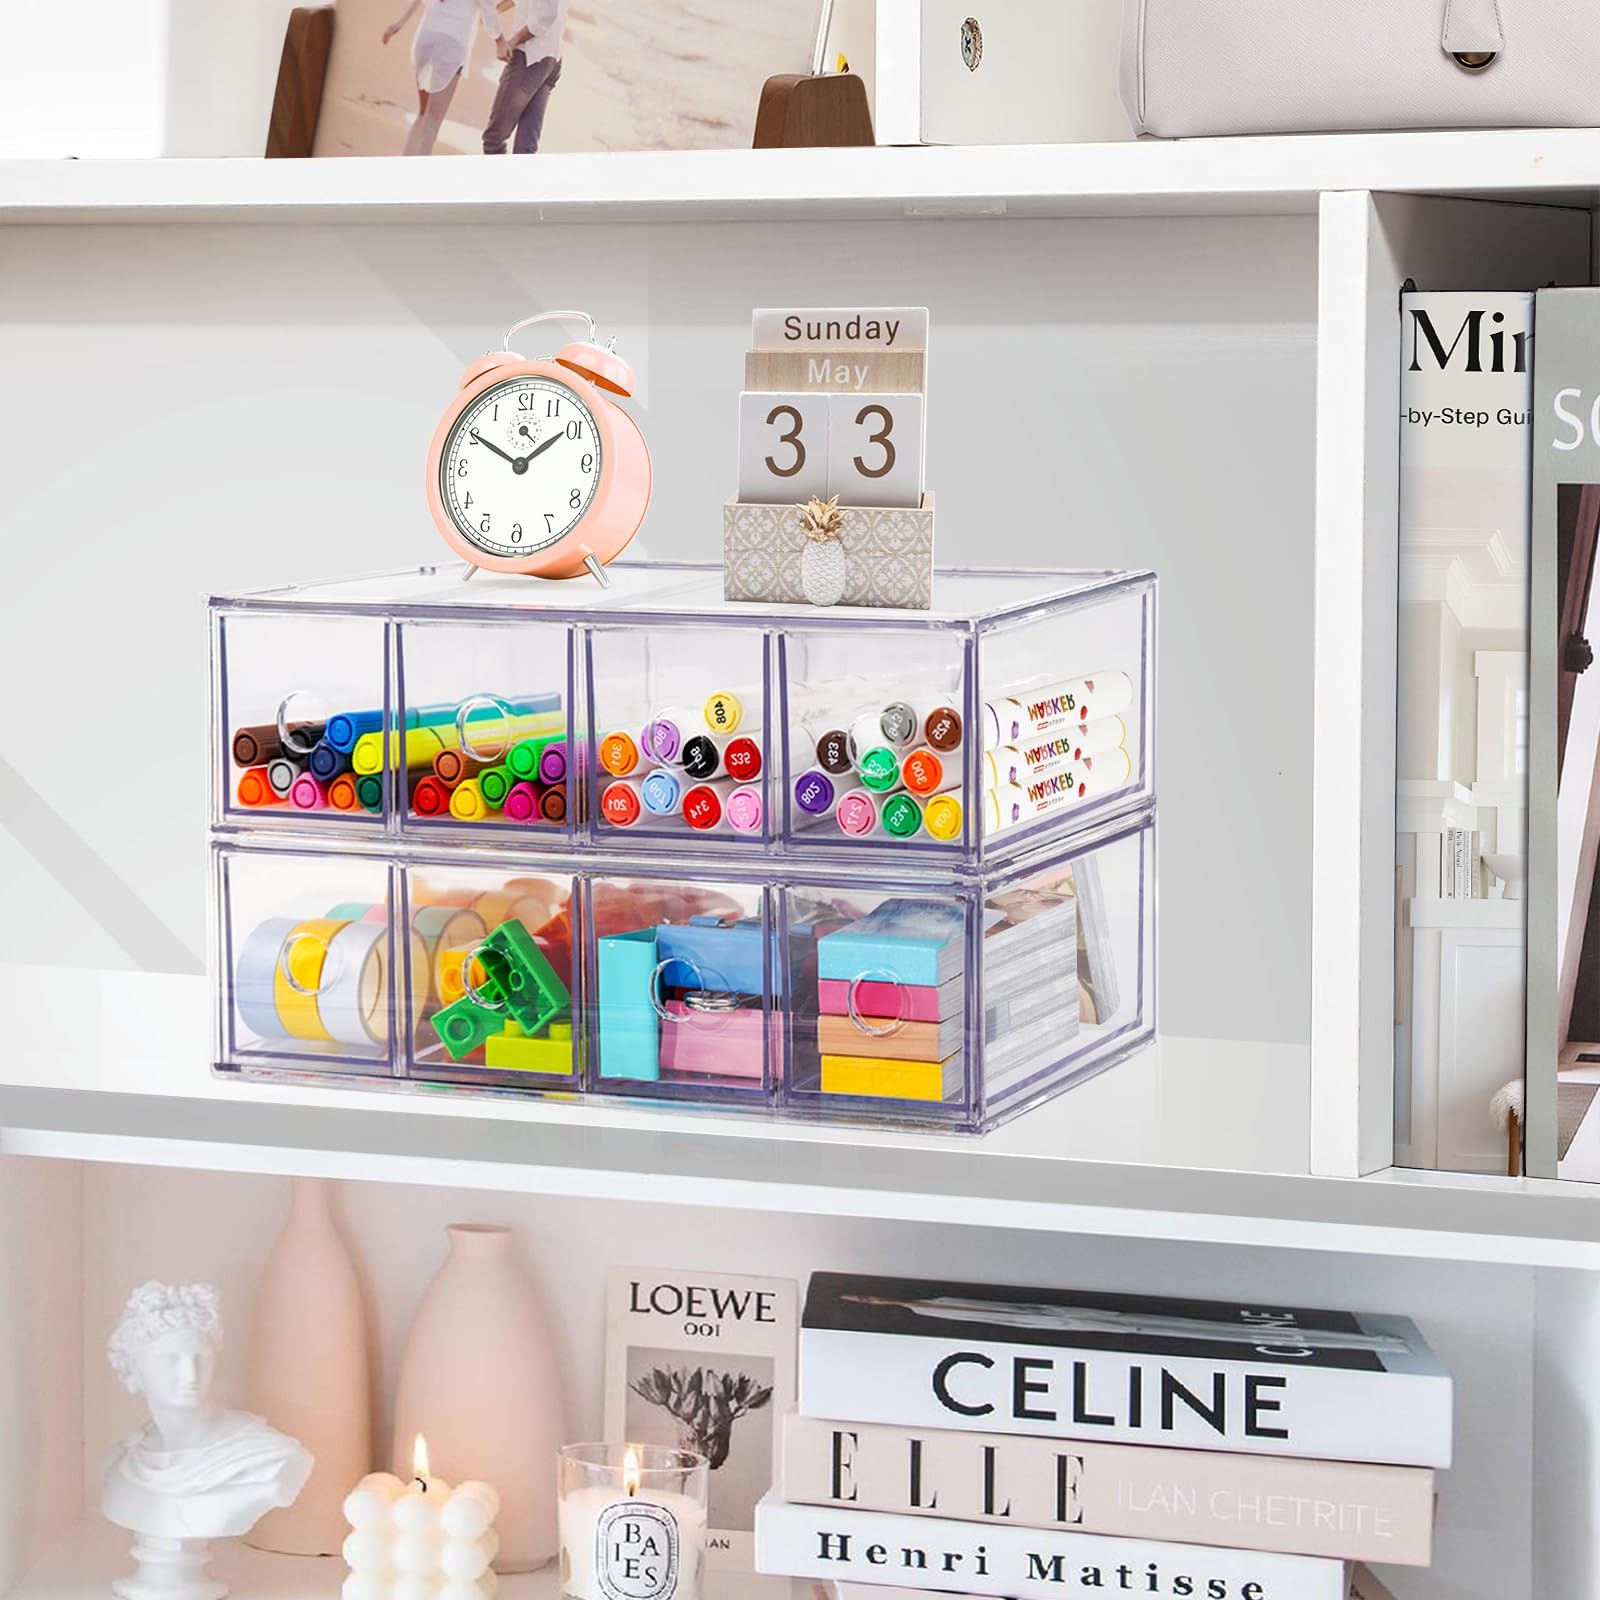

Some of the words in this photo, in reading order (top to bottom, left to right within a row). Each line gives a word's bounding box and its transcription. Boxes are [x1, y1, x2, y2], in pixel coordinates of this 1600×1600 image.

[784, 314, 900, 346] Sunday
[808, 358, 868, 390] May
[765, 404, 806, 477] 3
[853, 404, 896, 478] 3
[1552, 388, 1600, 450] S
[629, 1282, 776, 1322] LOEWE
[932, 1351, 1289, 1440] CELINE
[829, 1431, 1084, 1524] ELLE
[1116, 1479, 1196, 1516] ILAN
[1209, 1490, 1394, 1538] CHETRITE
[816, 1532, 989, 1575] Henri
[1025, 1553, 1264, 1600] Matisse
